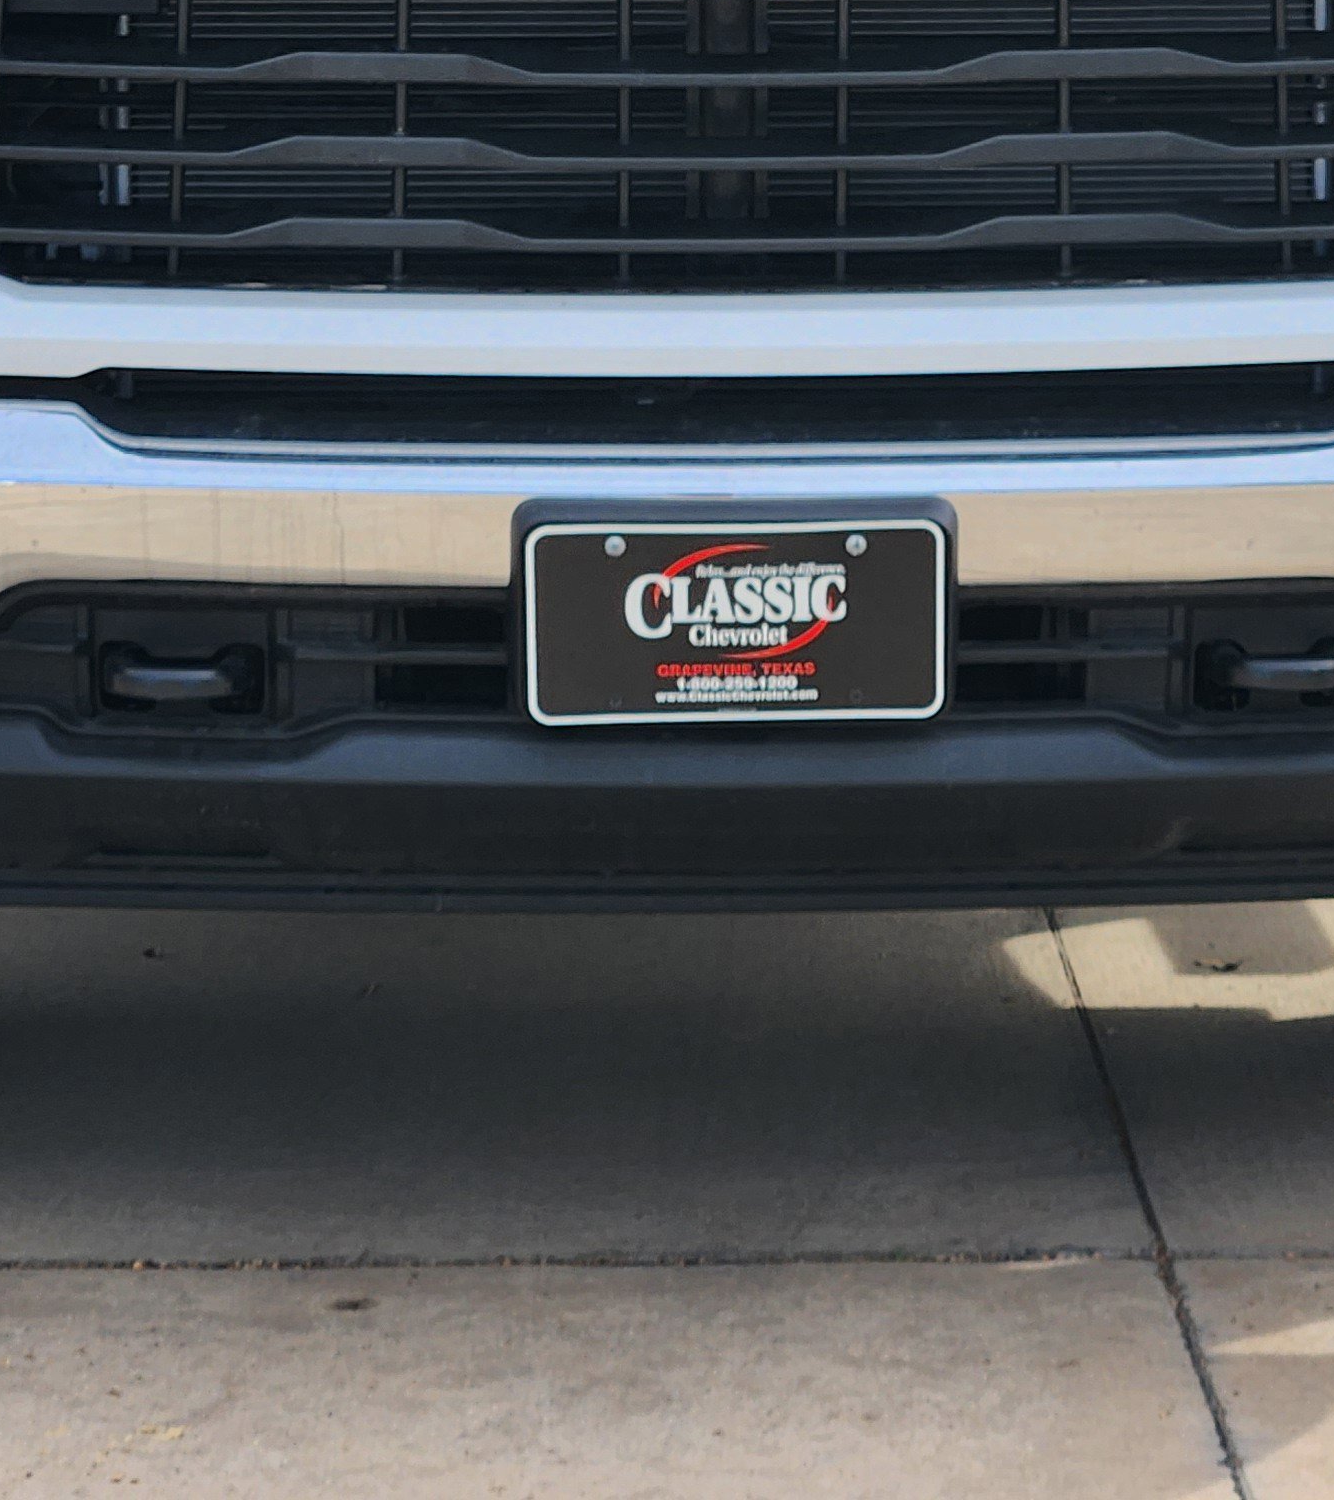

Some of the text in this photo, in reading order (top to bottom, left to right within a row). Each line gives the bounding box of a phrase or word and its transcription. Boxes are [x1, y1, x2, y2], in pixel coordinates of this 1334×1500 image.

[624, 573, 847, 639] CLASSIC
[688, 623, 788, 647] Chevrolet
[761, 662, 816, 675] TEXAS
